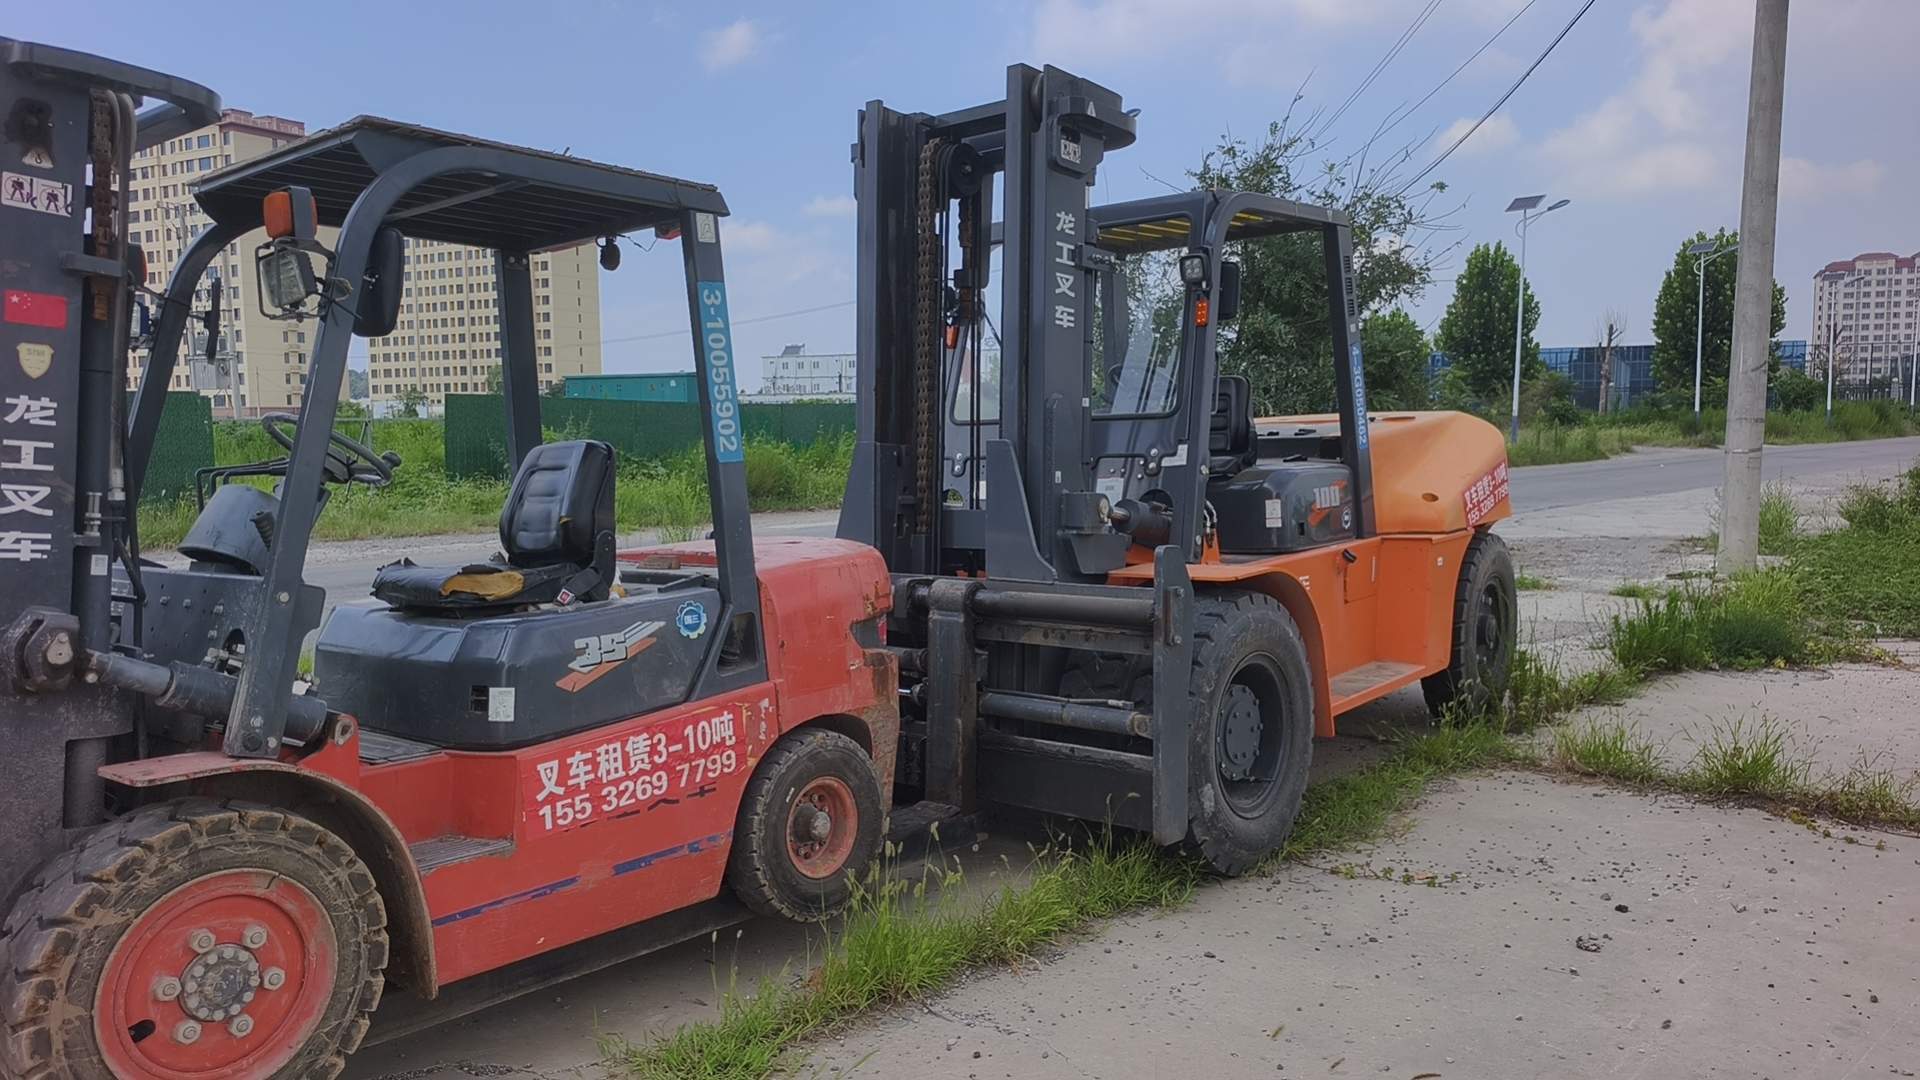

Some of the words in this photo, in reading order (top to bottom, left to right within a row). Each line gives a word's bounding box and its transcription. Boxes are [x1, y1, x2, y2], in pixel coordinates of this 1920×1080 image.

[1055, 211, 1075, 328] 龙工叉车
[703, 289, 738, 453] 3-10055902
[0, 394, 58, 562] 龙工叉车
[1313, 486, 1339, 508] 100
[571, 628, 636, 670] 35
[536, 710, 736, 801] 叉车租赁3-10吨
[538, 793, 593, 831] 155
[601, 770, 668, 812] 3269
[676, 750, 736, 788] 7799
